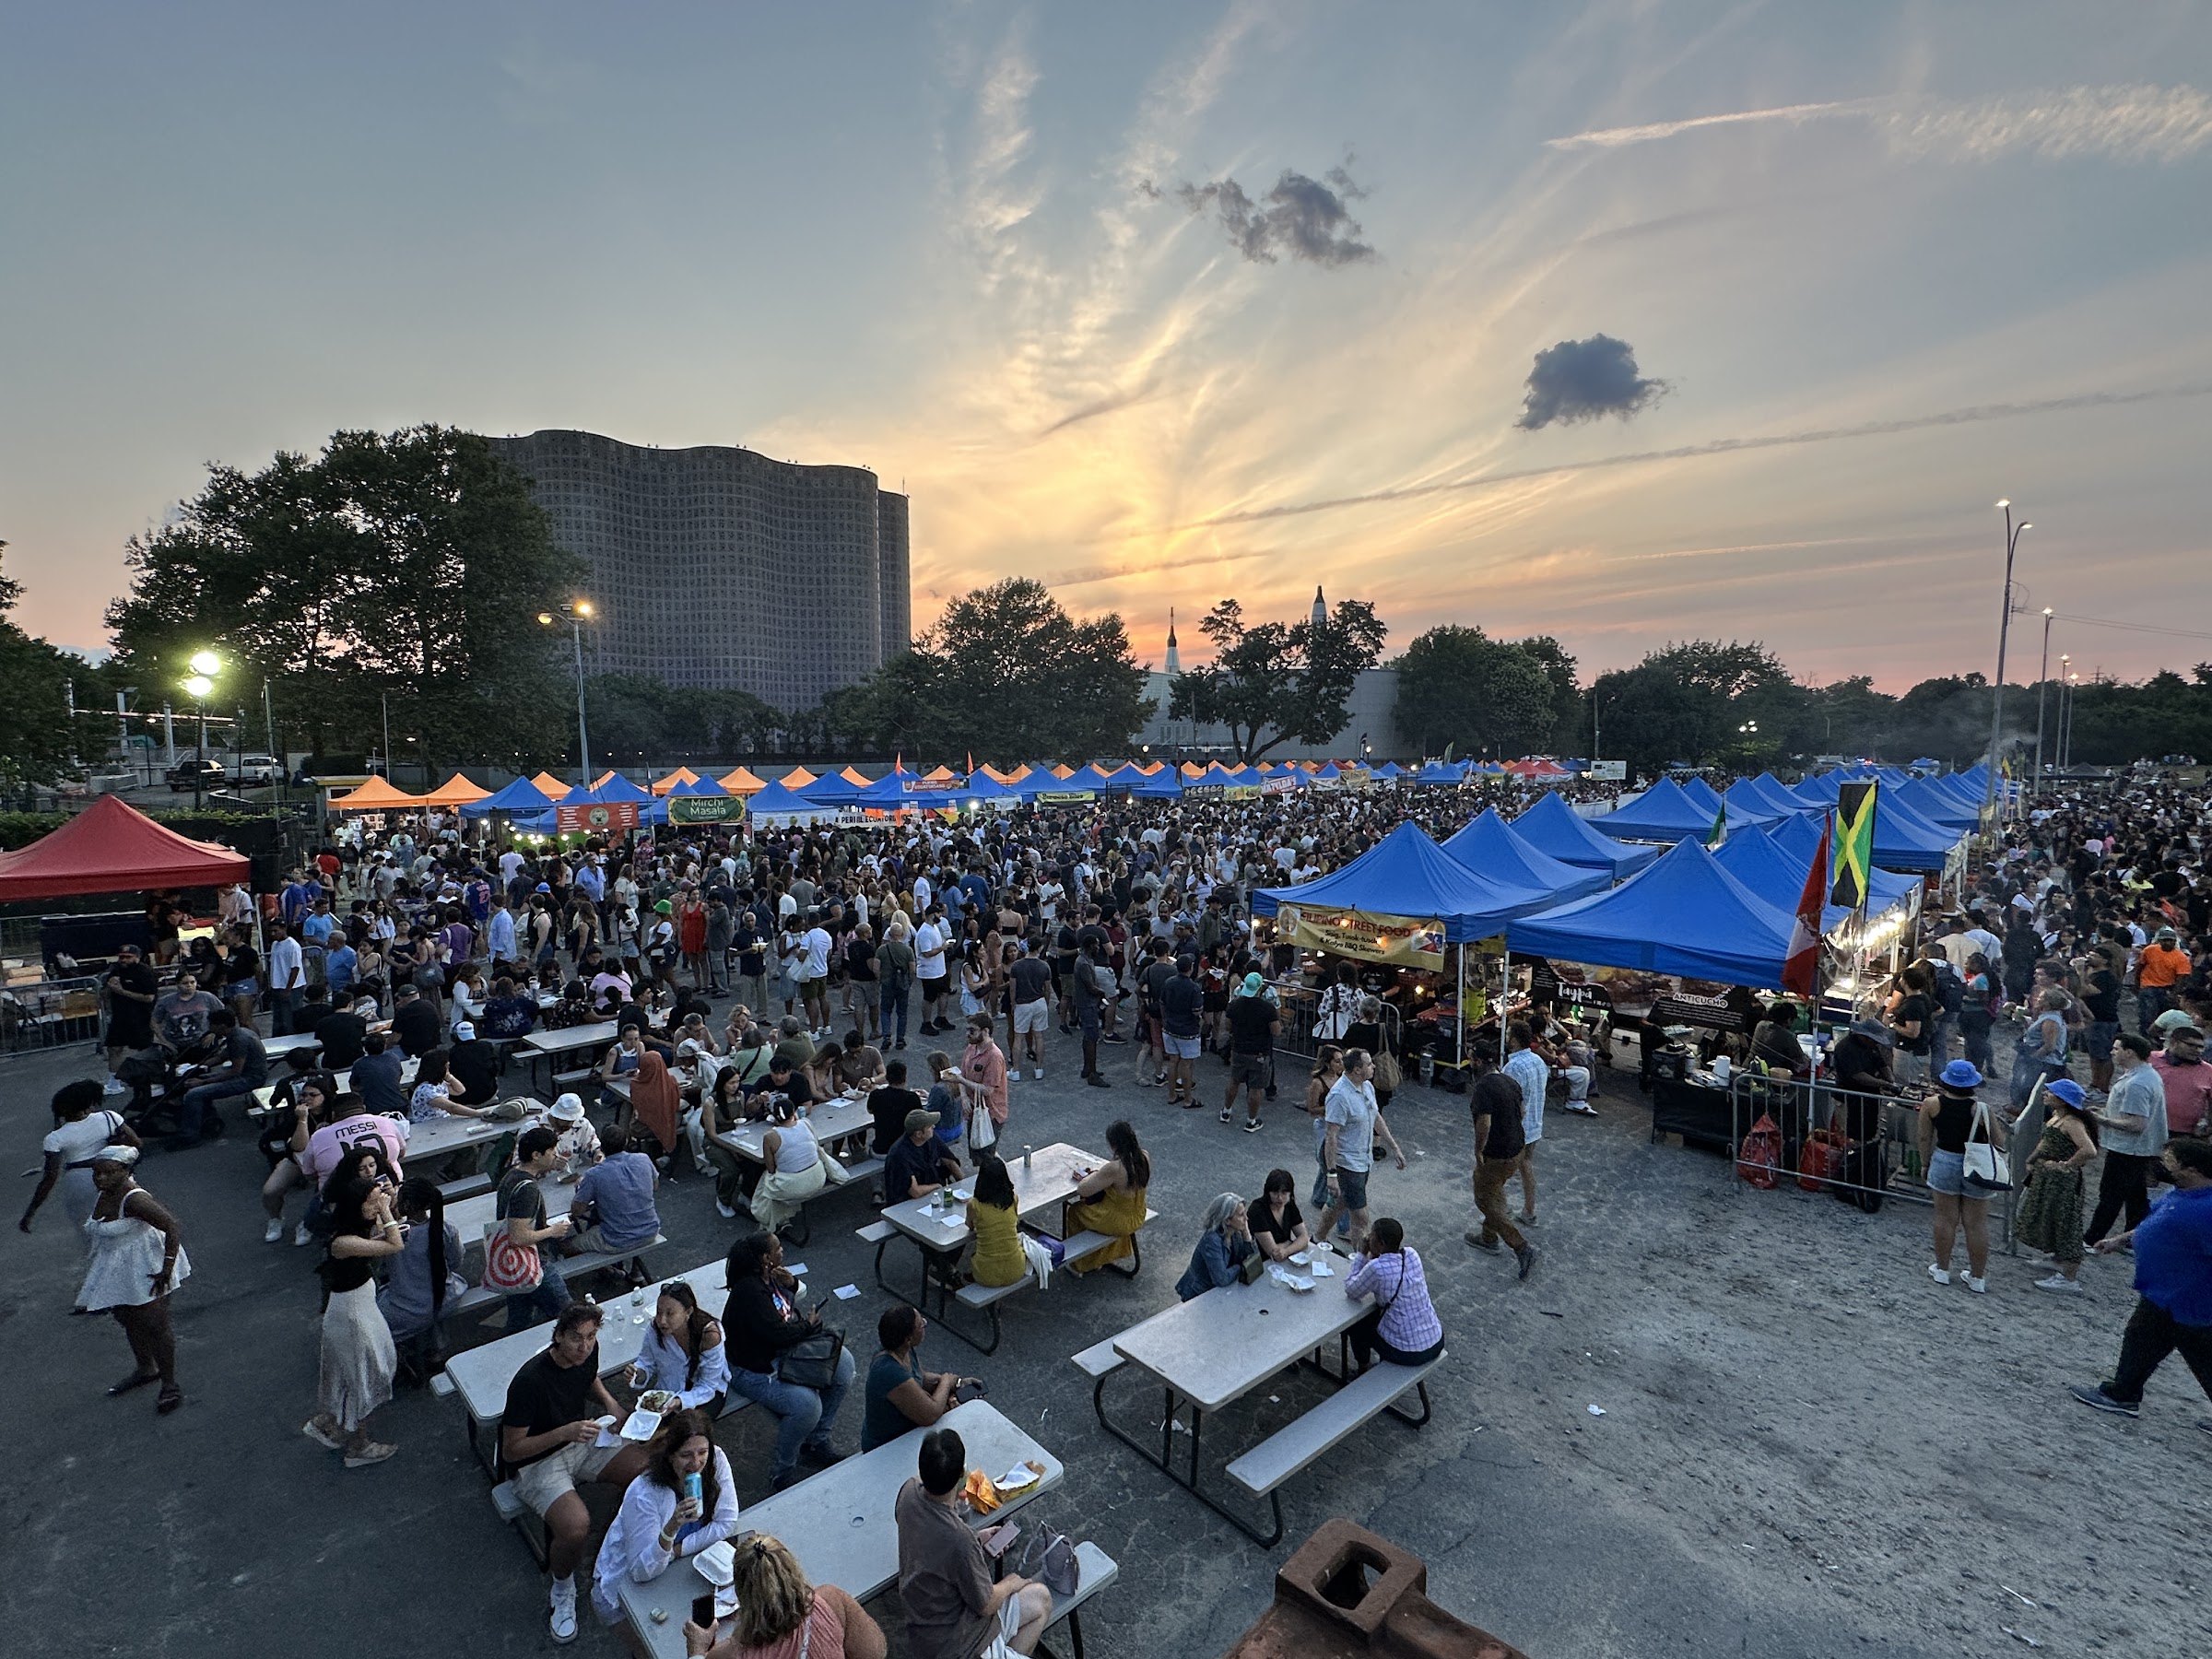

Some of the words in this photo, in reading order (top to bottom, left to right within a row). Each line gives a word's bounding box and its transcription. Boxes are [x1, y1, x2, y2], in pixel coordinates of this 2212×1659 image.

[690, 798, 724, 807] Mirchi
[689, 806, 726, 816] Masala
[1300, 912, 1340, 926] FILIPINO
[1343, 918, 1379, 934] TREET
[1379, 925, 1411, 937] FOOD
[1556, 982, 1593, 1003] Taypá
[1673, 993, 1728, 1008] ANTICUCHO
[335, 1121, 378, 1139] MESSI
